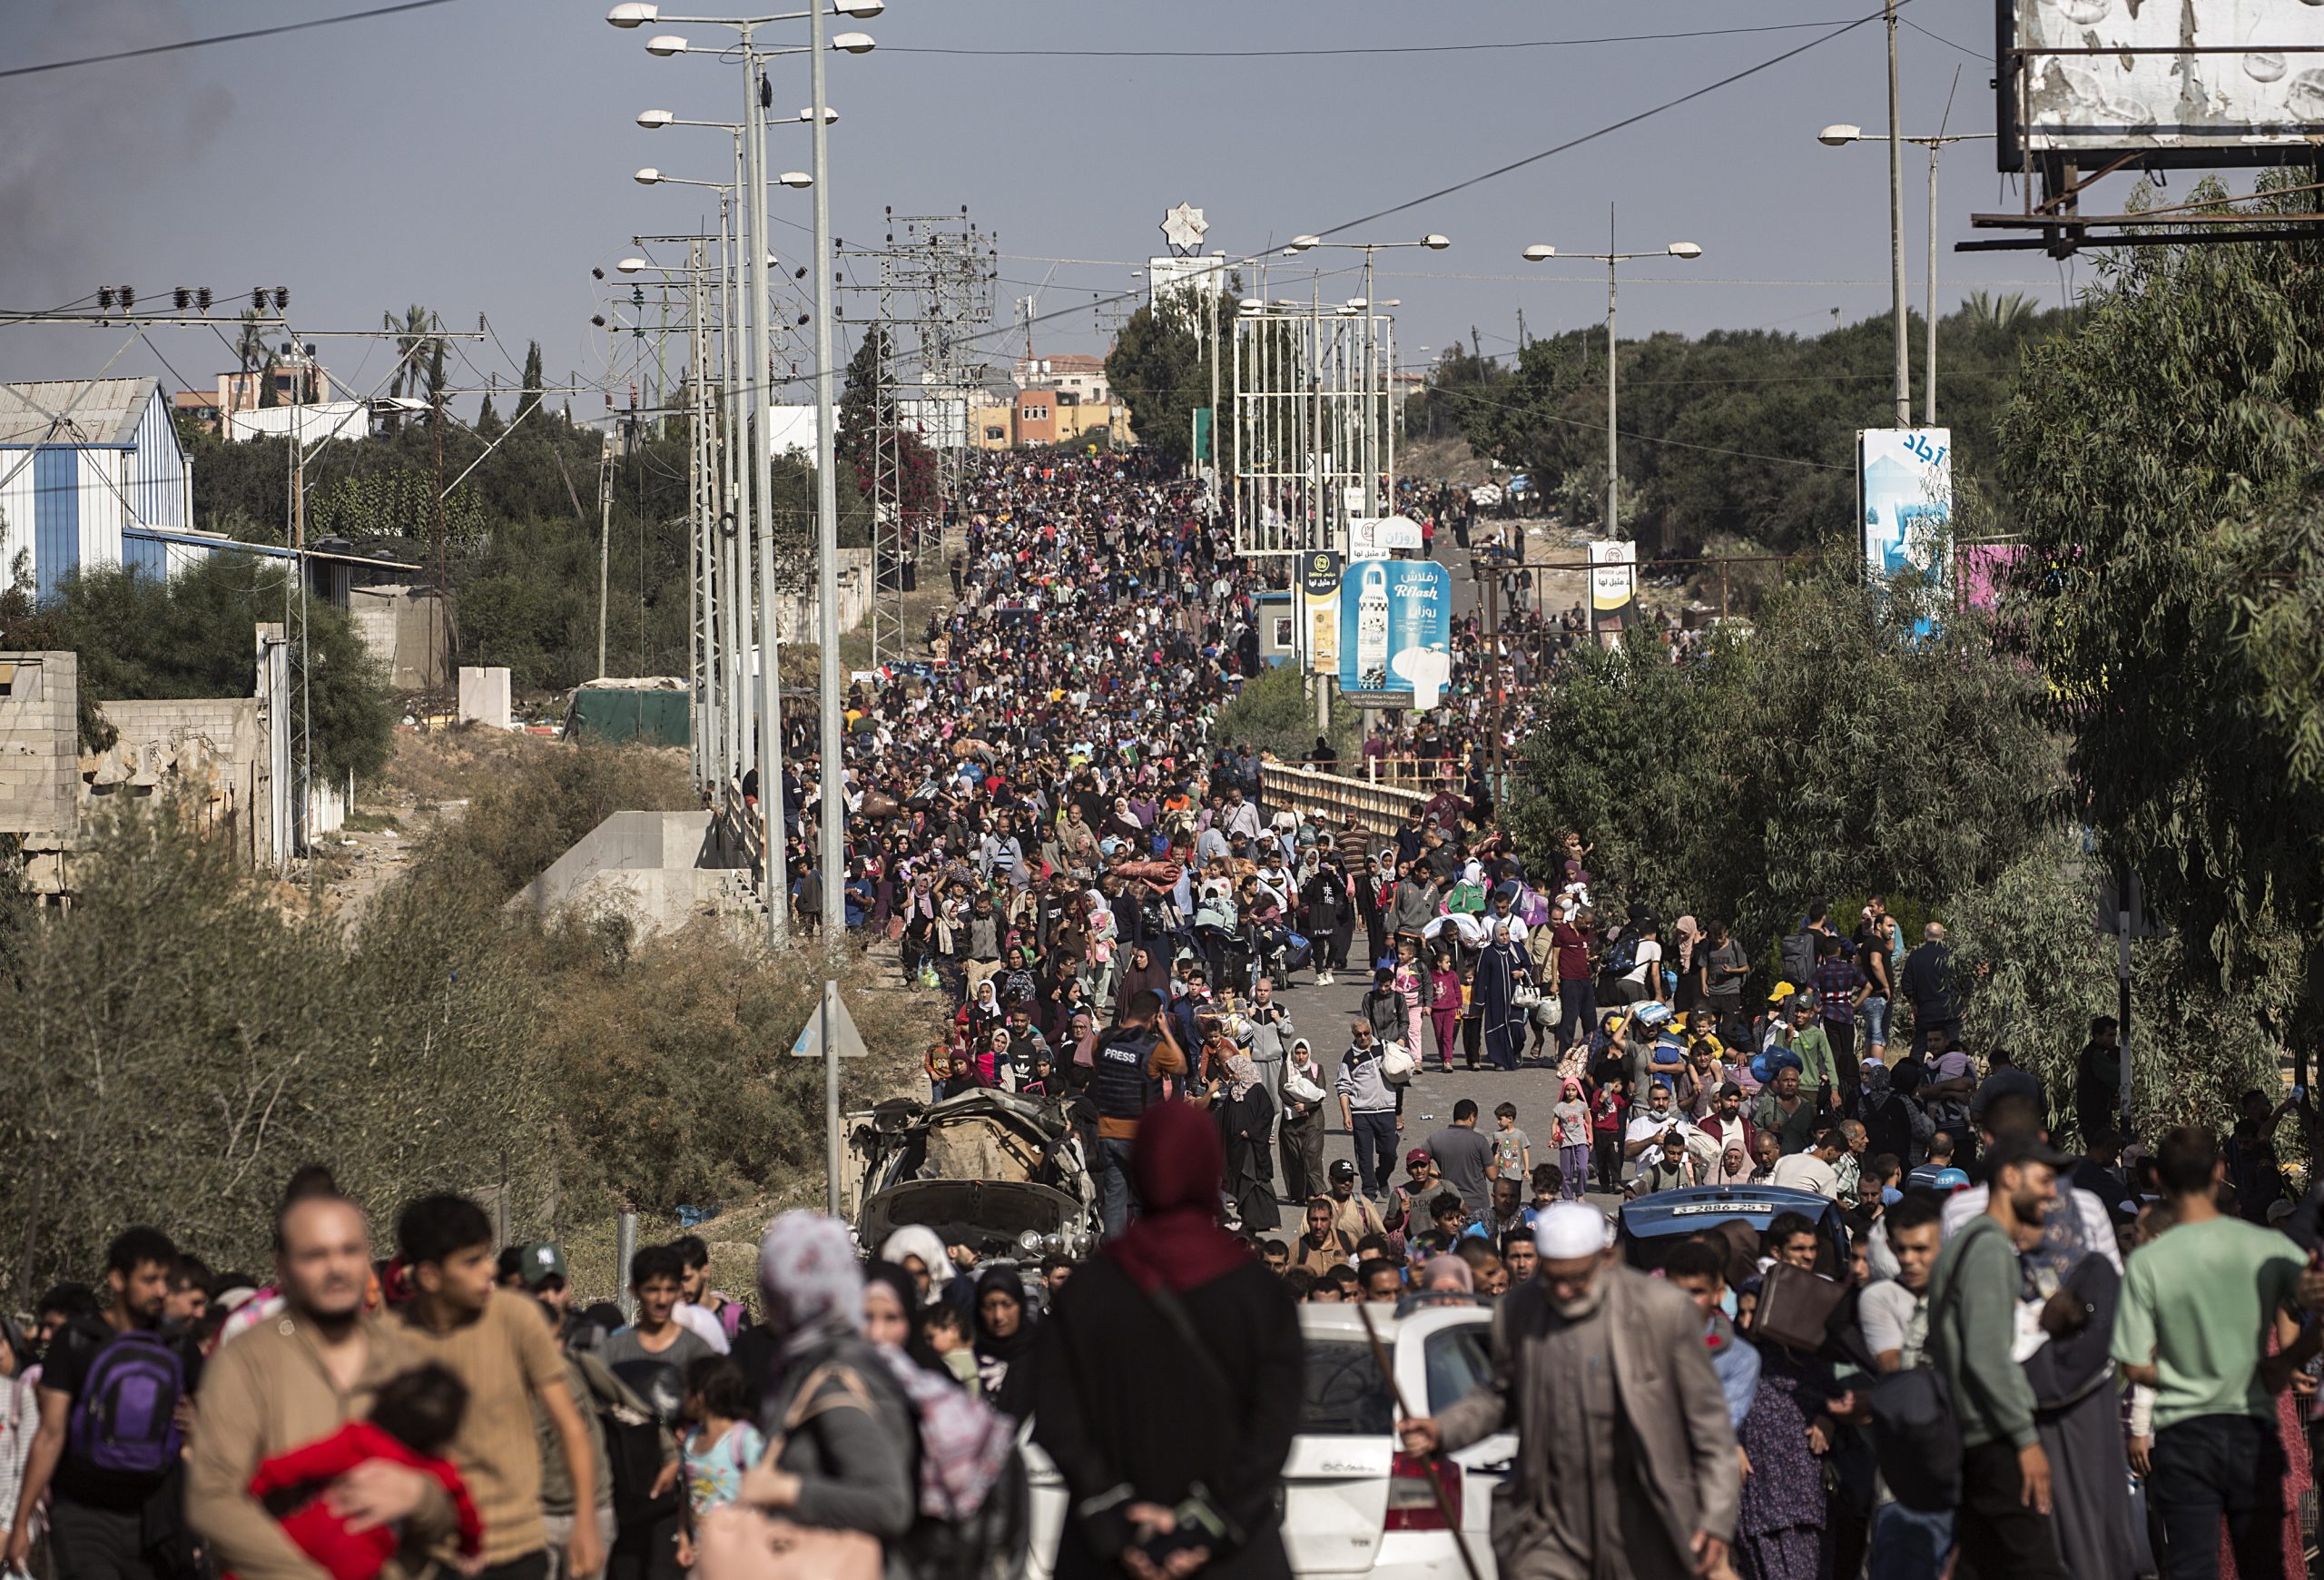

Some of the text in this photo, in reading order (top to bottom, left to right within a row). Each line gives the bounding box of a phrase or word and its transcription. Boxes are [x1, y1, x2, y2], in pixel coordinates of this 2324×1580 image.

[1385, 532, 1415, 545] روزان
[1401, 569, 1439, 584] رفلاش
[1393, 584, 1439, 600] Rflash
[1104, 1048, 1137, 1063] PRESS
